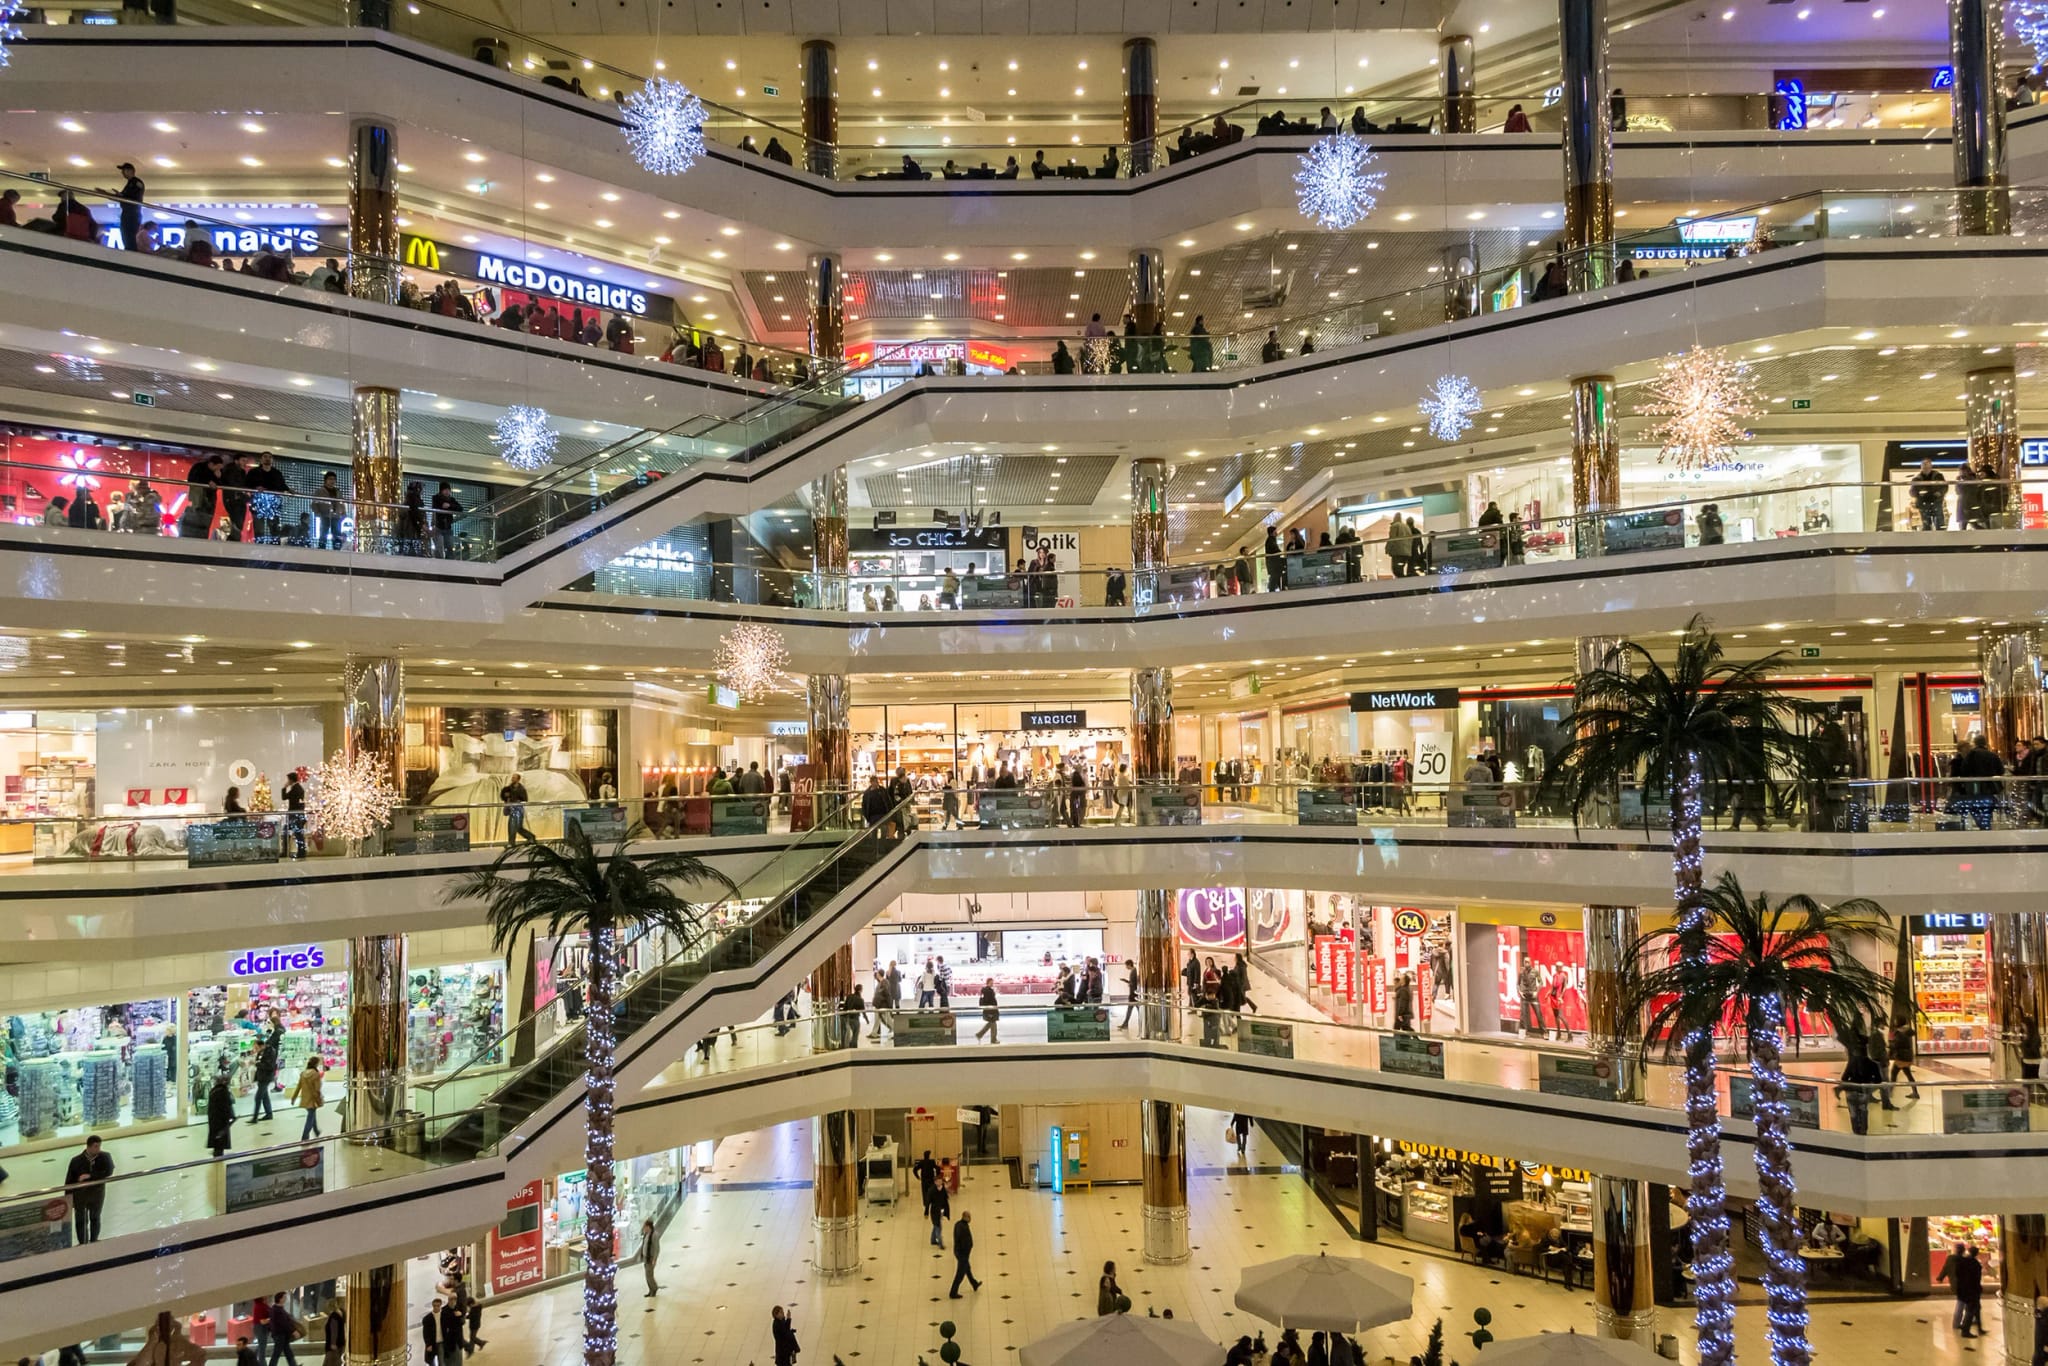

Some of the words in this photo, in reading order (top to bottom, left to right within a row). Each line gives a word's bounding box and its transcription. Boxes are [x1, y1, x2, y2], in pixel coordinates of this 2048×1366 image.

[1635, 249, 1728, 259] DOUGHNUT
[477, 255, 646, 315] McDonald's
[1703, 462, 1764, 472] Samsonite
[916, 532, 954, 546] CHIC
[1371, 692, 1436, 709] NetWork
[1418, 752, 1446, 775] 50
[1398, 914, 1422, 930] C&A
[233, 945, 325, 976] claire's
[496, 1266, 540, 1288] Tefal
